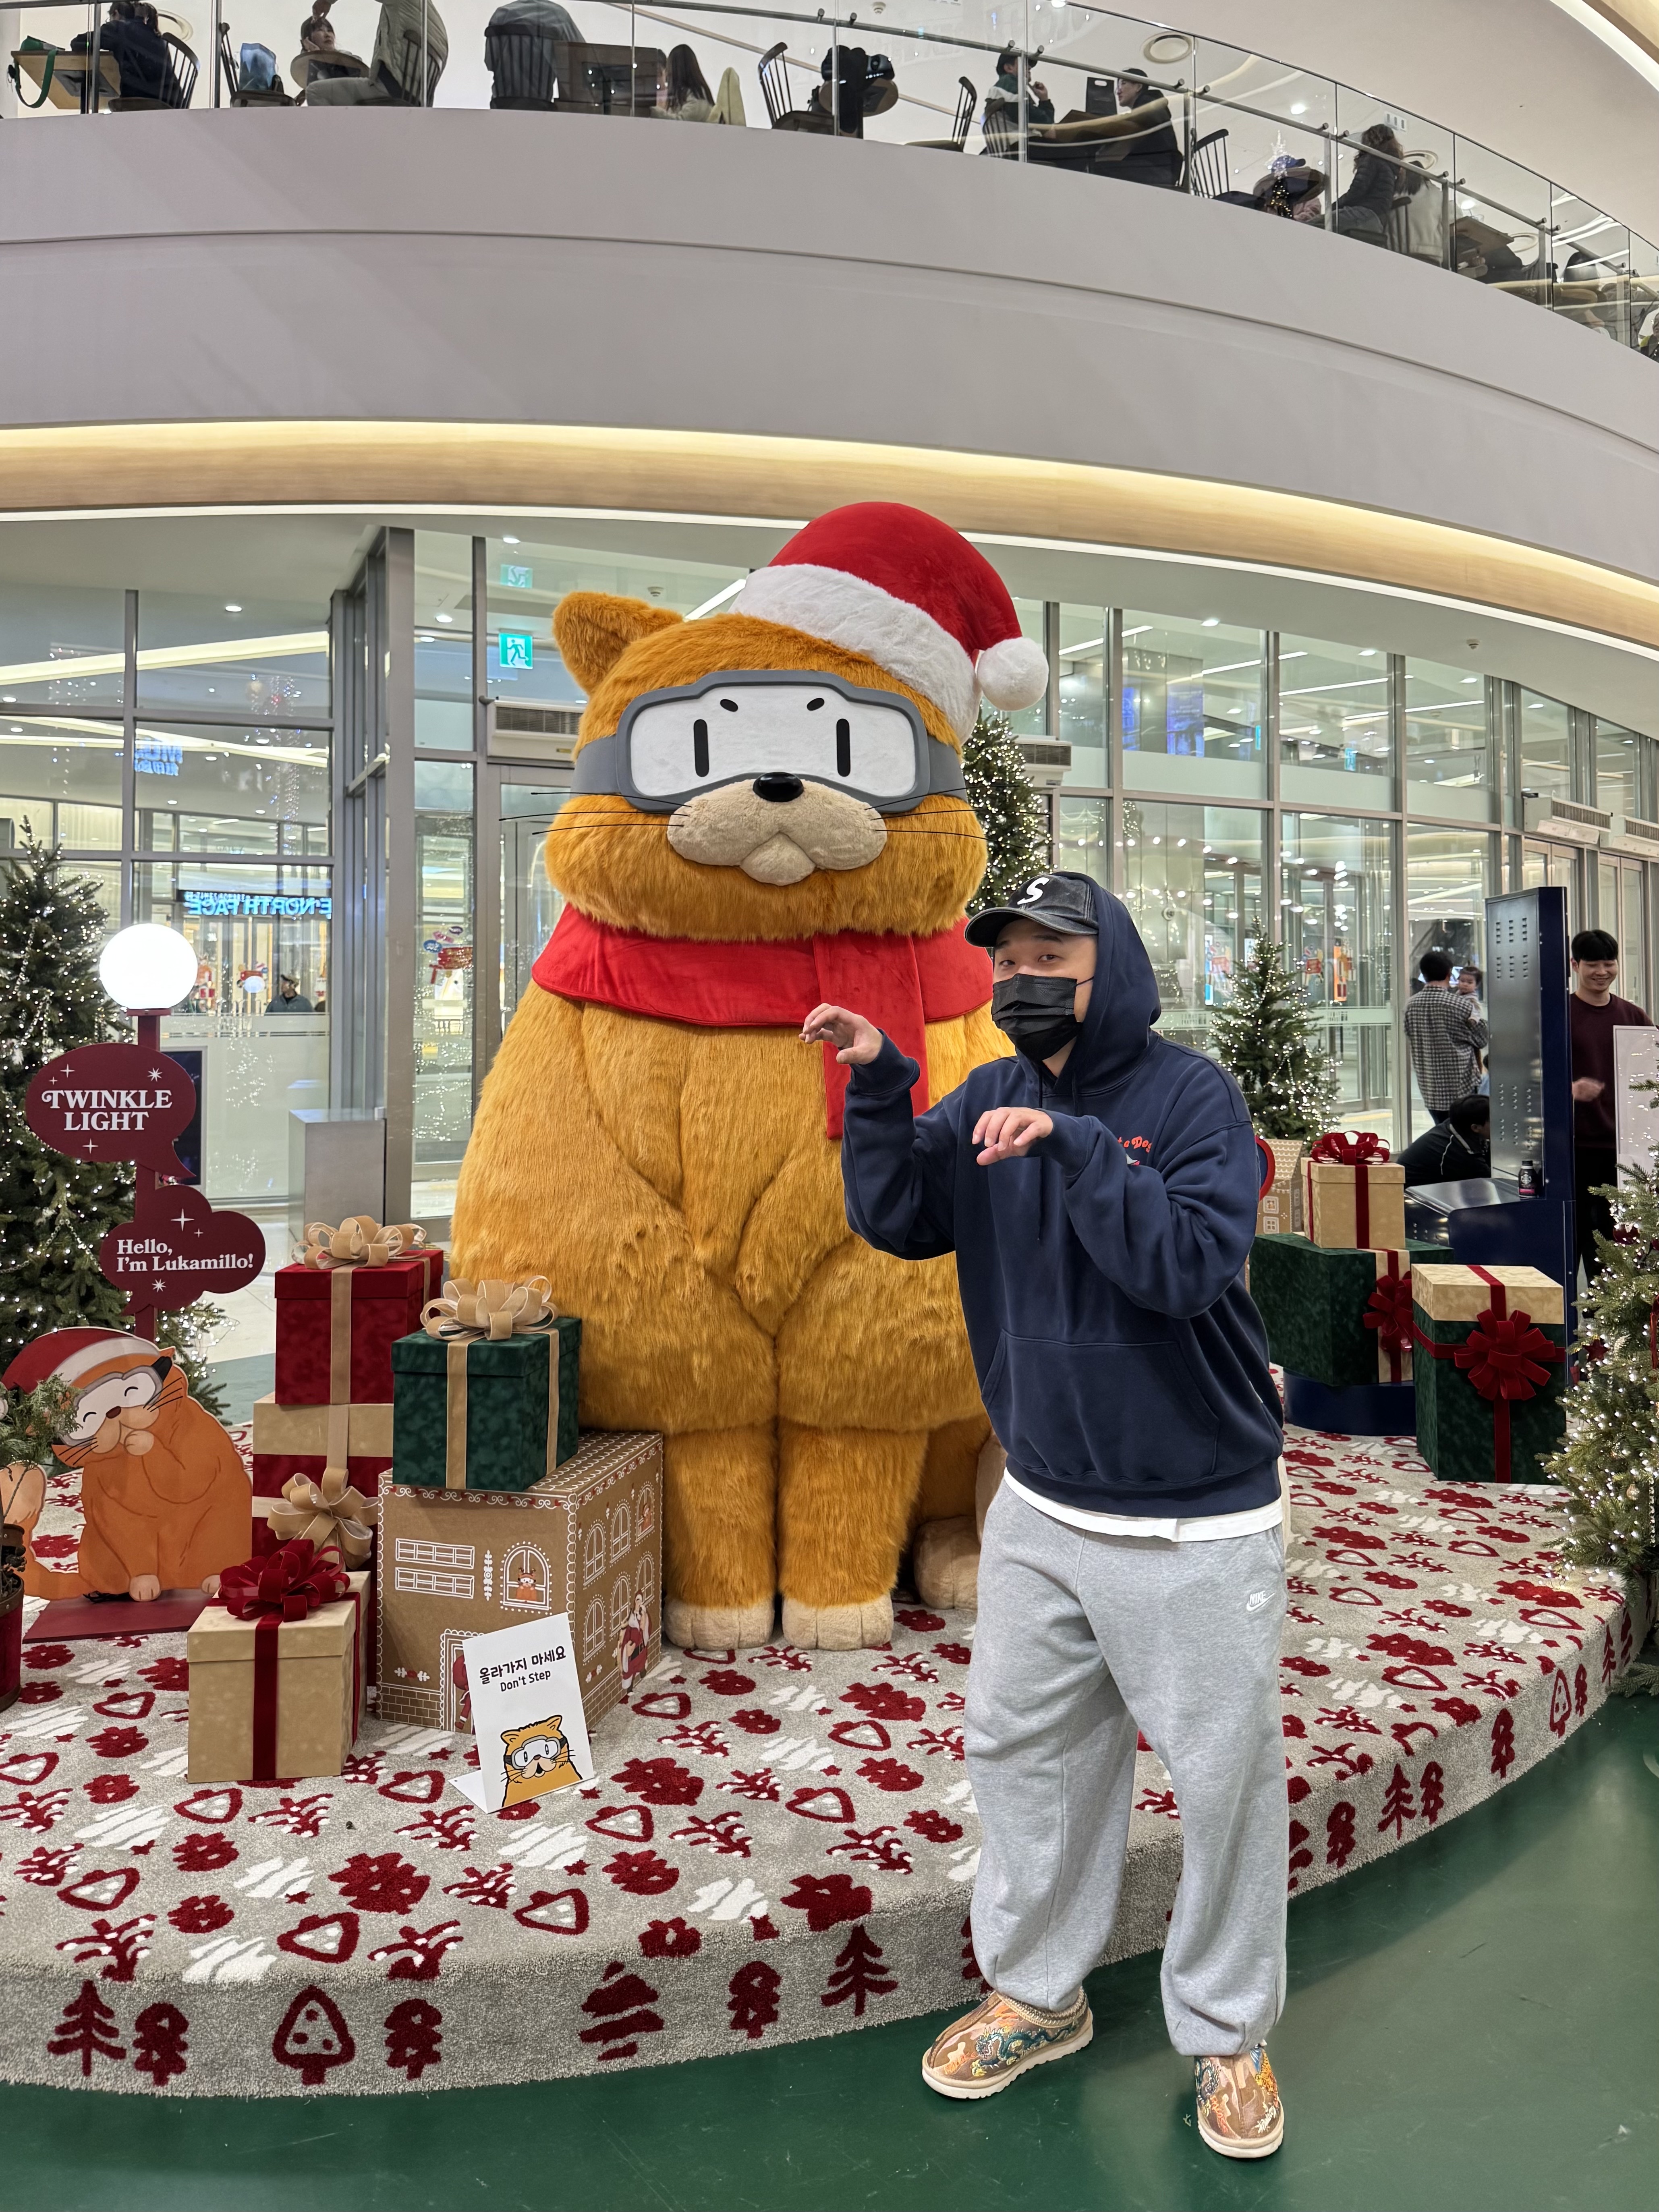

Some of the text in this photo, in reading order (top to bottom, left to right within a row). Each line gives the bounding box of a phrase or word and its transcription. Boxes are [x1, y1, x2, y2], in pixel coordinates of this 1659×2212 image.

[1017, 877, 1050, 905] S
[41, 1090, 172, 1109] TWINKLE
[64, 1111, 149, 1130] LIGHT
[117, 1239, 172, 1256] Hello,
[116, 1253, 253, 1272] I'm Lukamillo!
[1250, 1590, 1266, 1605] NIKE
[480, 1646, 566, 1685] 올라가지 마세요
[500, 1671, 551, 1692] Don't Step
